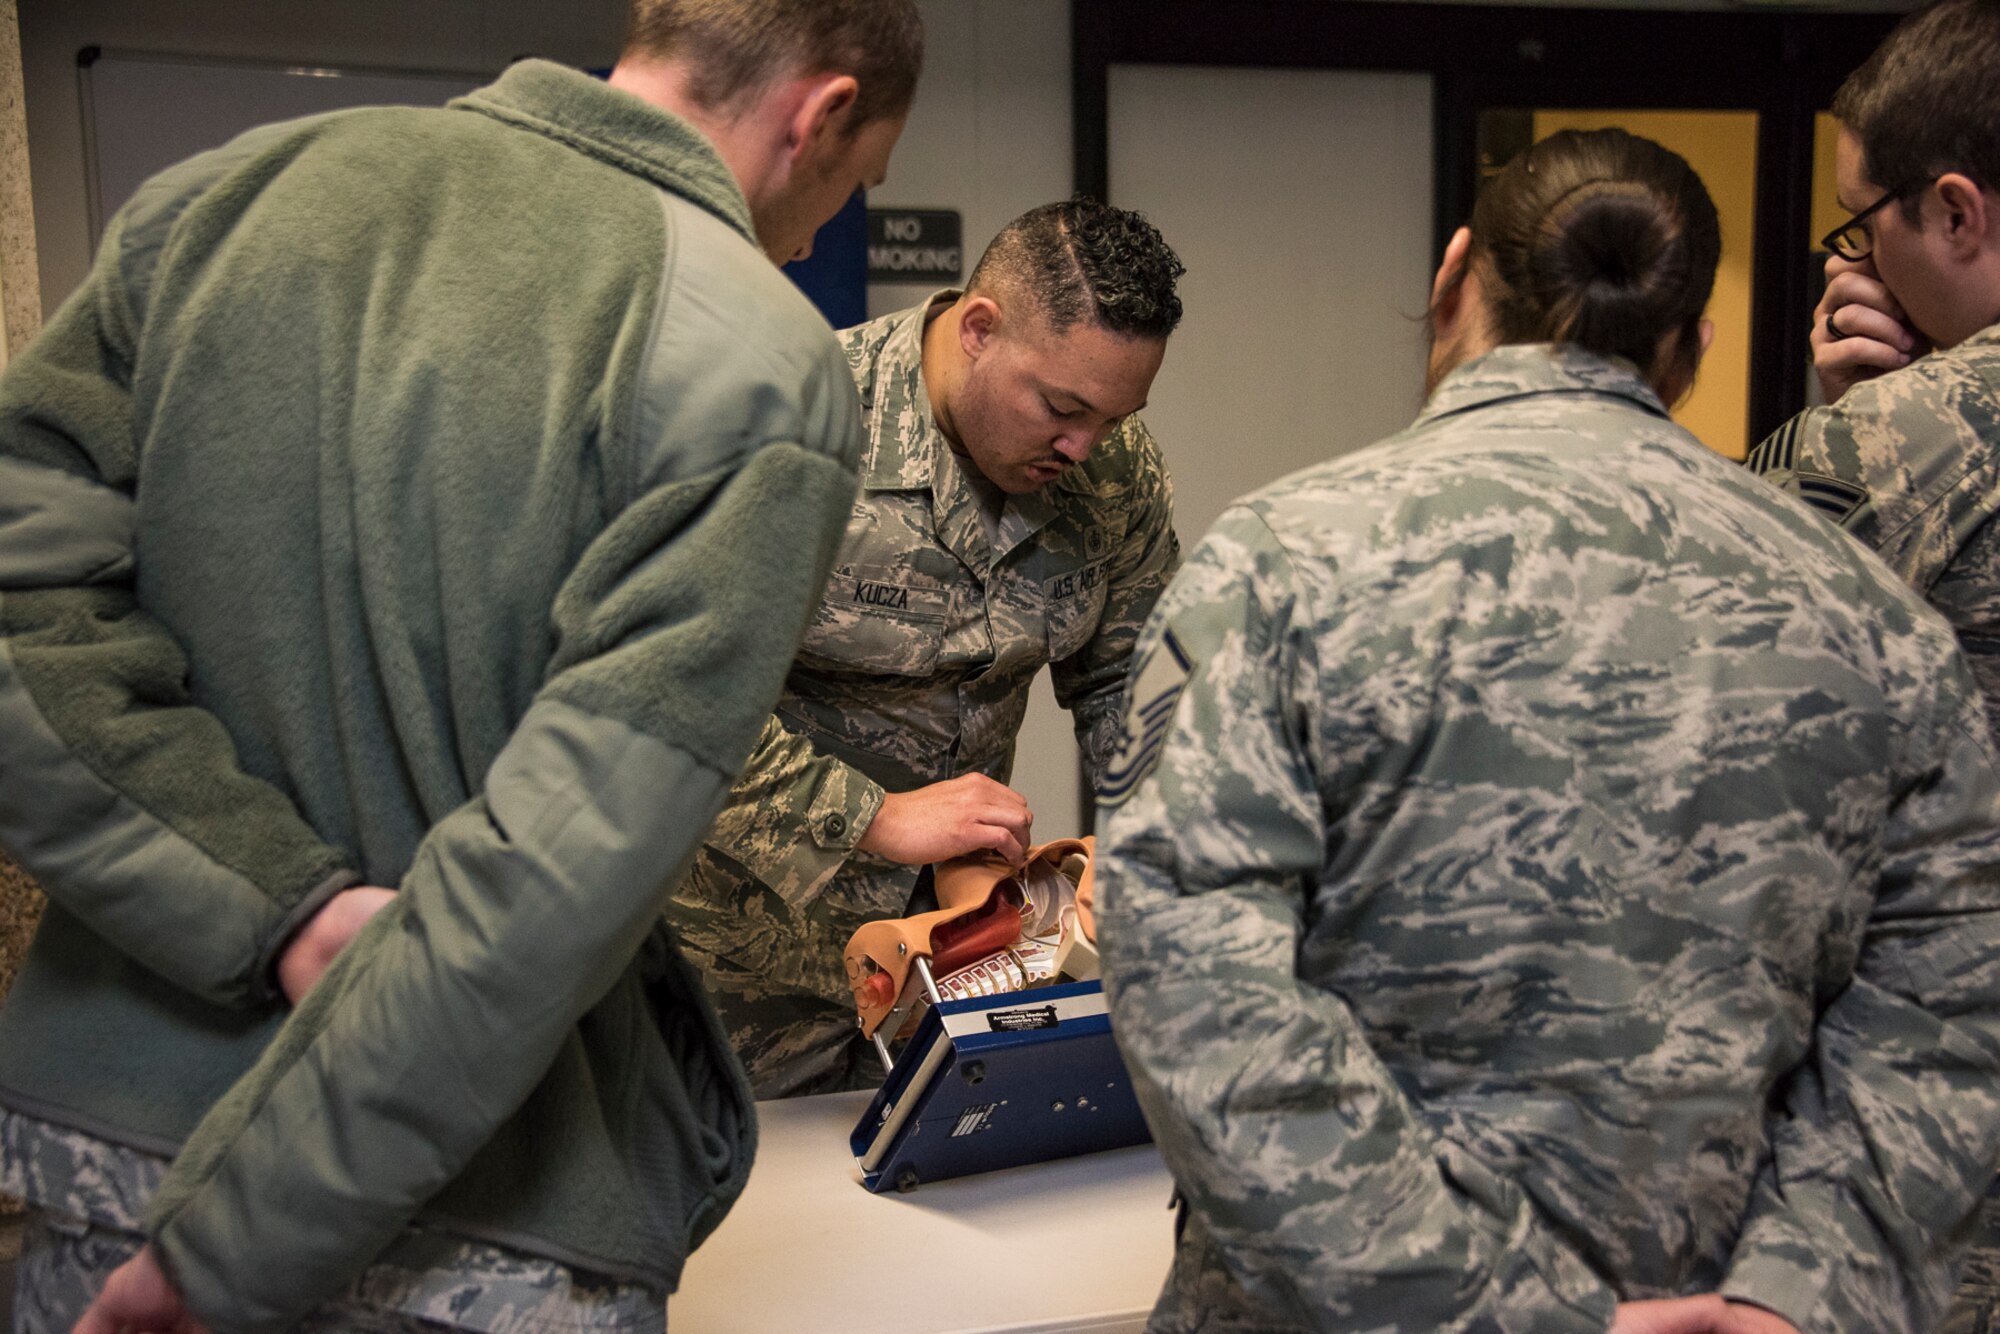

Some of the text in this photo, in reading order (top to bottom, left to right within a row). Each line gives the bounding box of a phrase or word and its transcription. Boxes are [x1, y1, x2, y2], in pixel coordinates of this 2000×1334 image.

[884, 218, 921, 241] NO
[868, 246, 960, 272] MOKING
[853, 581, 908, 610] KUCZA
